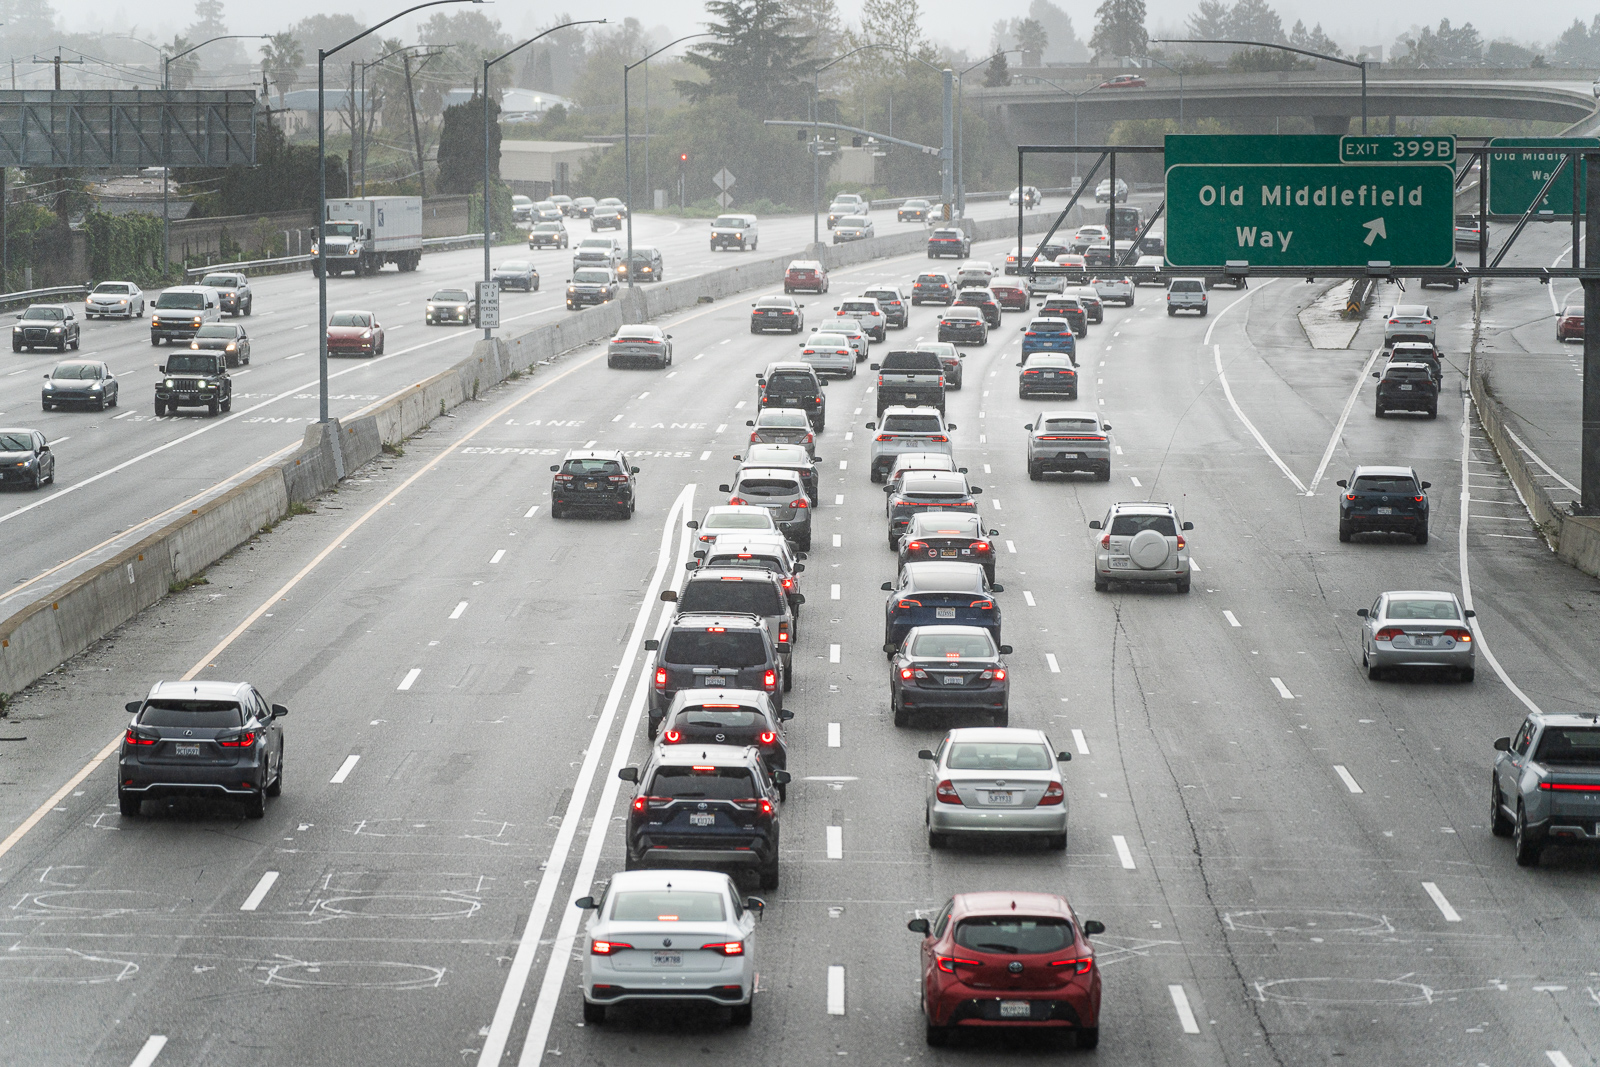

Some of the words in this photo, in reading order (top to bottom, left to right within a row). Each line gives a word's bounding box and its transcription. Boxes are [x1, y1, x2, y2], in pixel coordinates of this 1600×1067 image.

[1346, 144, 1379, 155] EXIT
[1393, 141, 1450, 157] 399B
[1532, 171, 1553, 180] Wa
[1199, 185, 1244, 206] Old
[1262, 185, 1422, 206] Middlefield
[1236, 226, 1293, 252] Way
[505, 419, 585, 427] LANE
[461, 447, 561, 455] EXPRS
